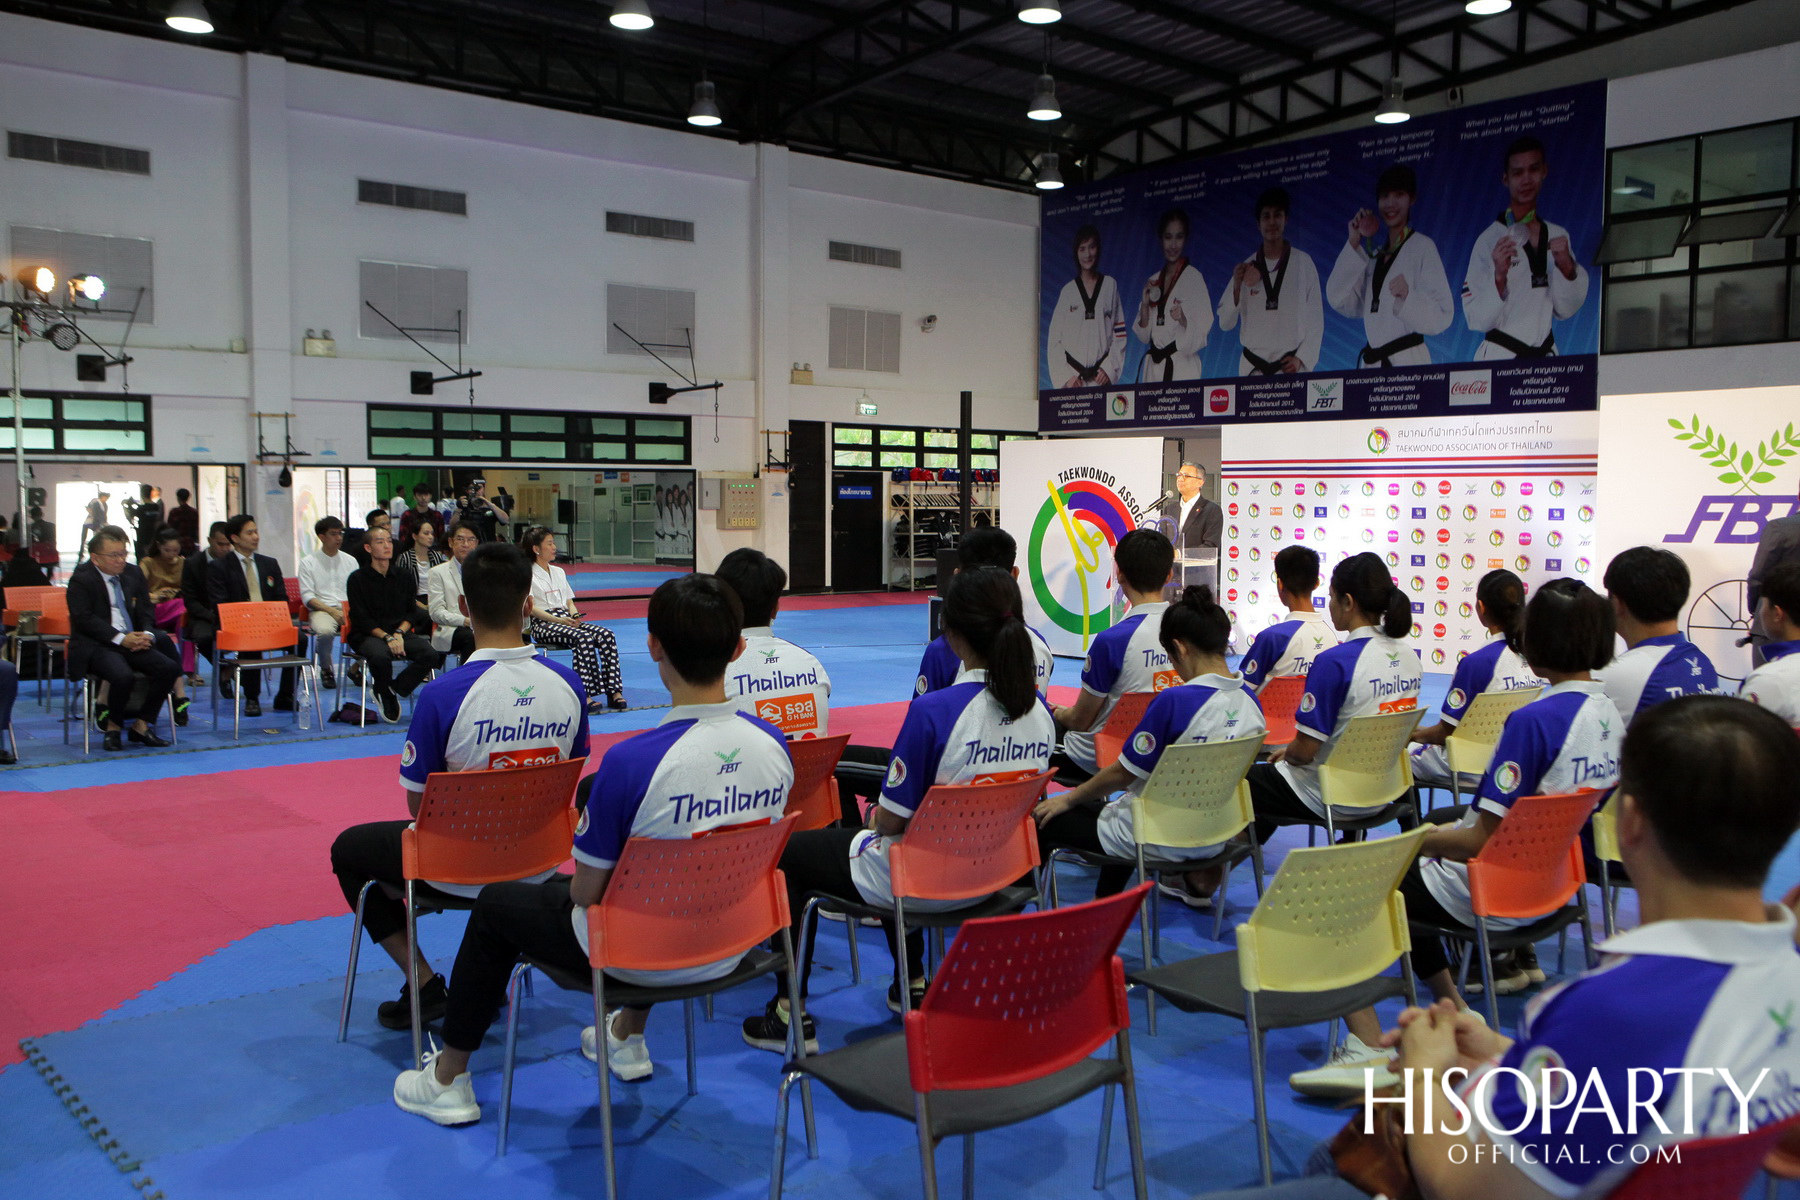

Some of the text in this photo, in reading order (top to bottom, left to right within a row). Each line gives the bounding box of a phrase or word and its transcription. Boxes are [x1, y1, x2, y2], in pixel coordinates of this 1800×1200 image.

[1466, 119, 1486, 128] When
[1488, 117, 1501, 126] you
[1504, 112, 1517, 121] feel
[1520, 110, 1533, 118] like
[1460, 130, 1478, 140] Think
[1481, 127, 1502, 137] about
[1504, 124, 1519, 133] why
[1522, 121, 1536, 131] you
[1311, 397, 1337, 409] FBT
[1396, 441, 1553, 453] TAEKWONDO ASSOCIATION OF THAILAND
[1058, 466, 1143, 524] TAEKWONDO ASSOC
[1292, 657, 1312, 672] Tha
[733, 667, 818, 695] Thailand
[513, 697, 536, 706] FBT
[785, 700, 814, 714] ธอส
[474, 716, 571, 745] Thailand
[966, 734, 1050, 766] Thailand
[716, 762, 742, 775] FBT
[1571, 752, 1621, 785] Thaila
[669, 778, 784, 824] Thailand
